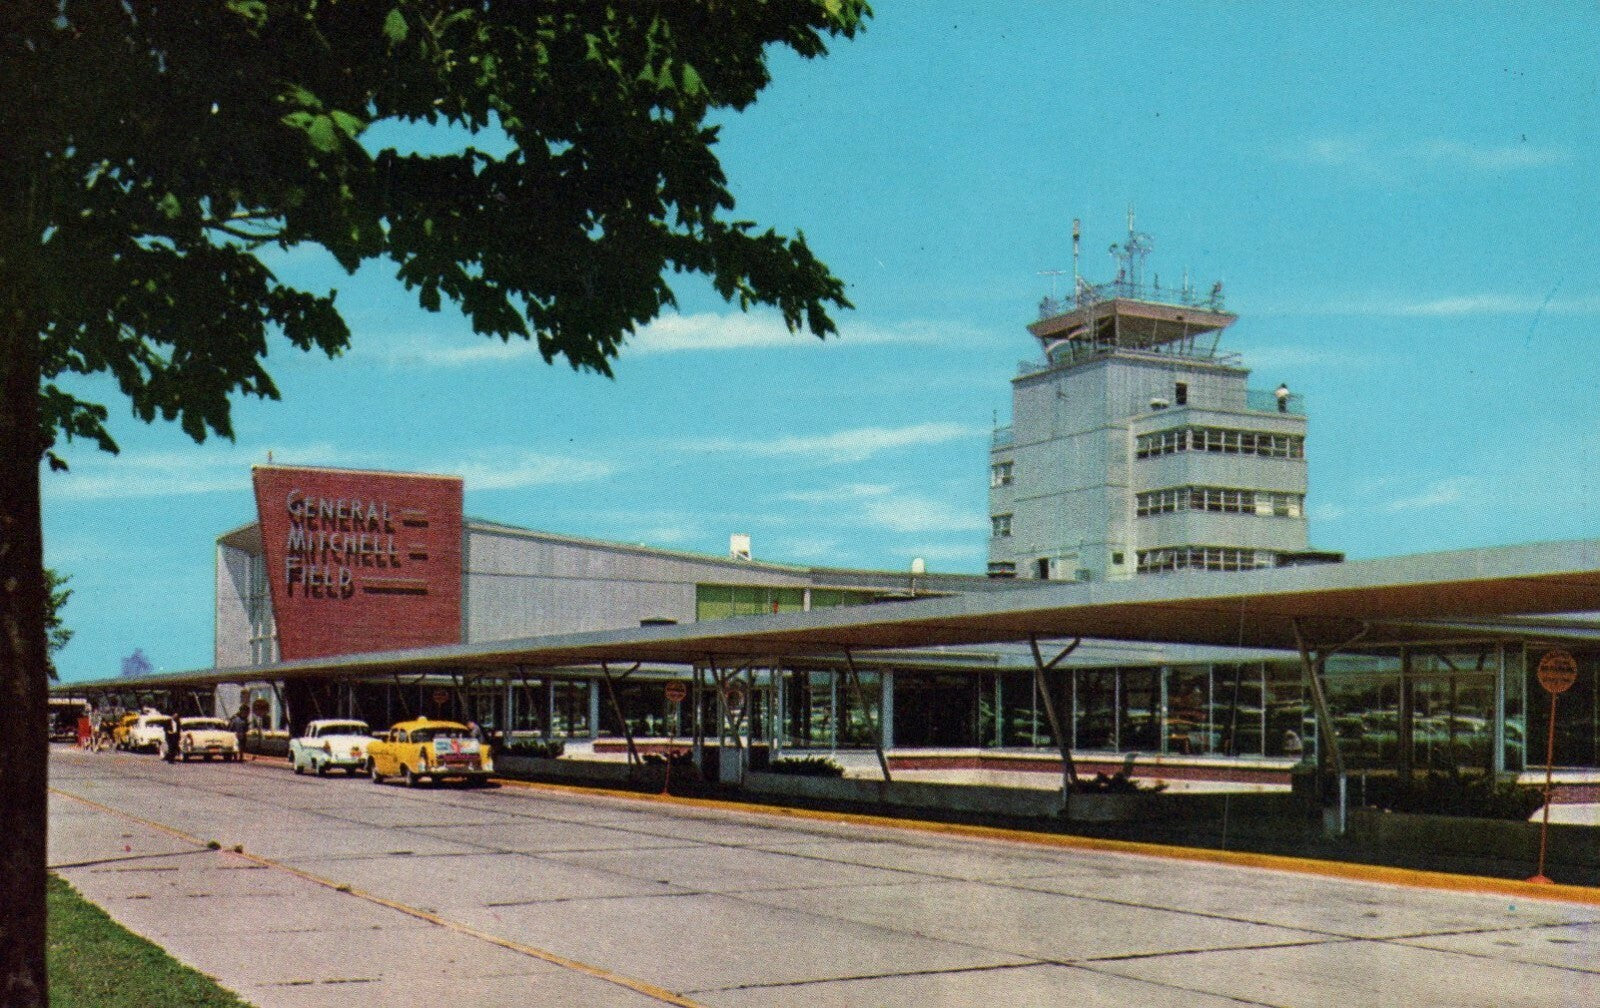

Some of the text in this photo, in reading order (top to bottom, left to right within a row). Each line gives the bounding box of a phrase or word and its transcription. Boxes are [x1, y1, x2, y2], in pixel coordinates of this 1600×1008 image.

[287, 488, 391, 522] GENERAL
[287, 522, 397, 555] MITCHELL
[286, 557, 353, 587] FIELD
